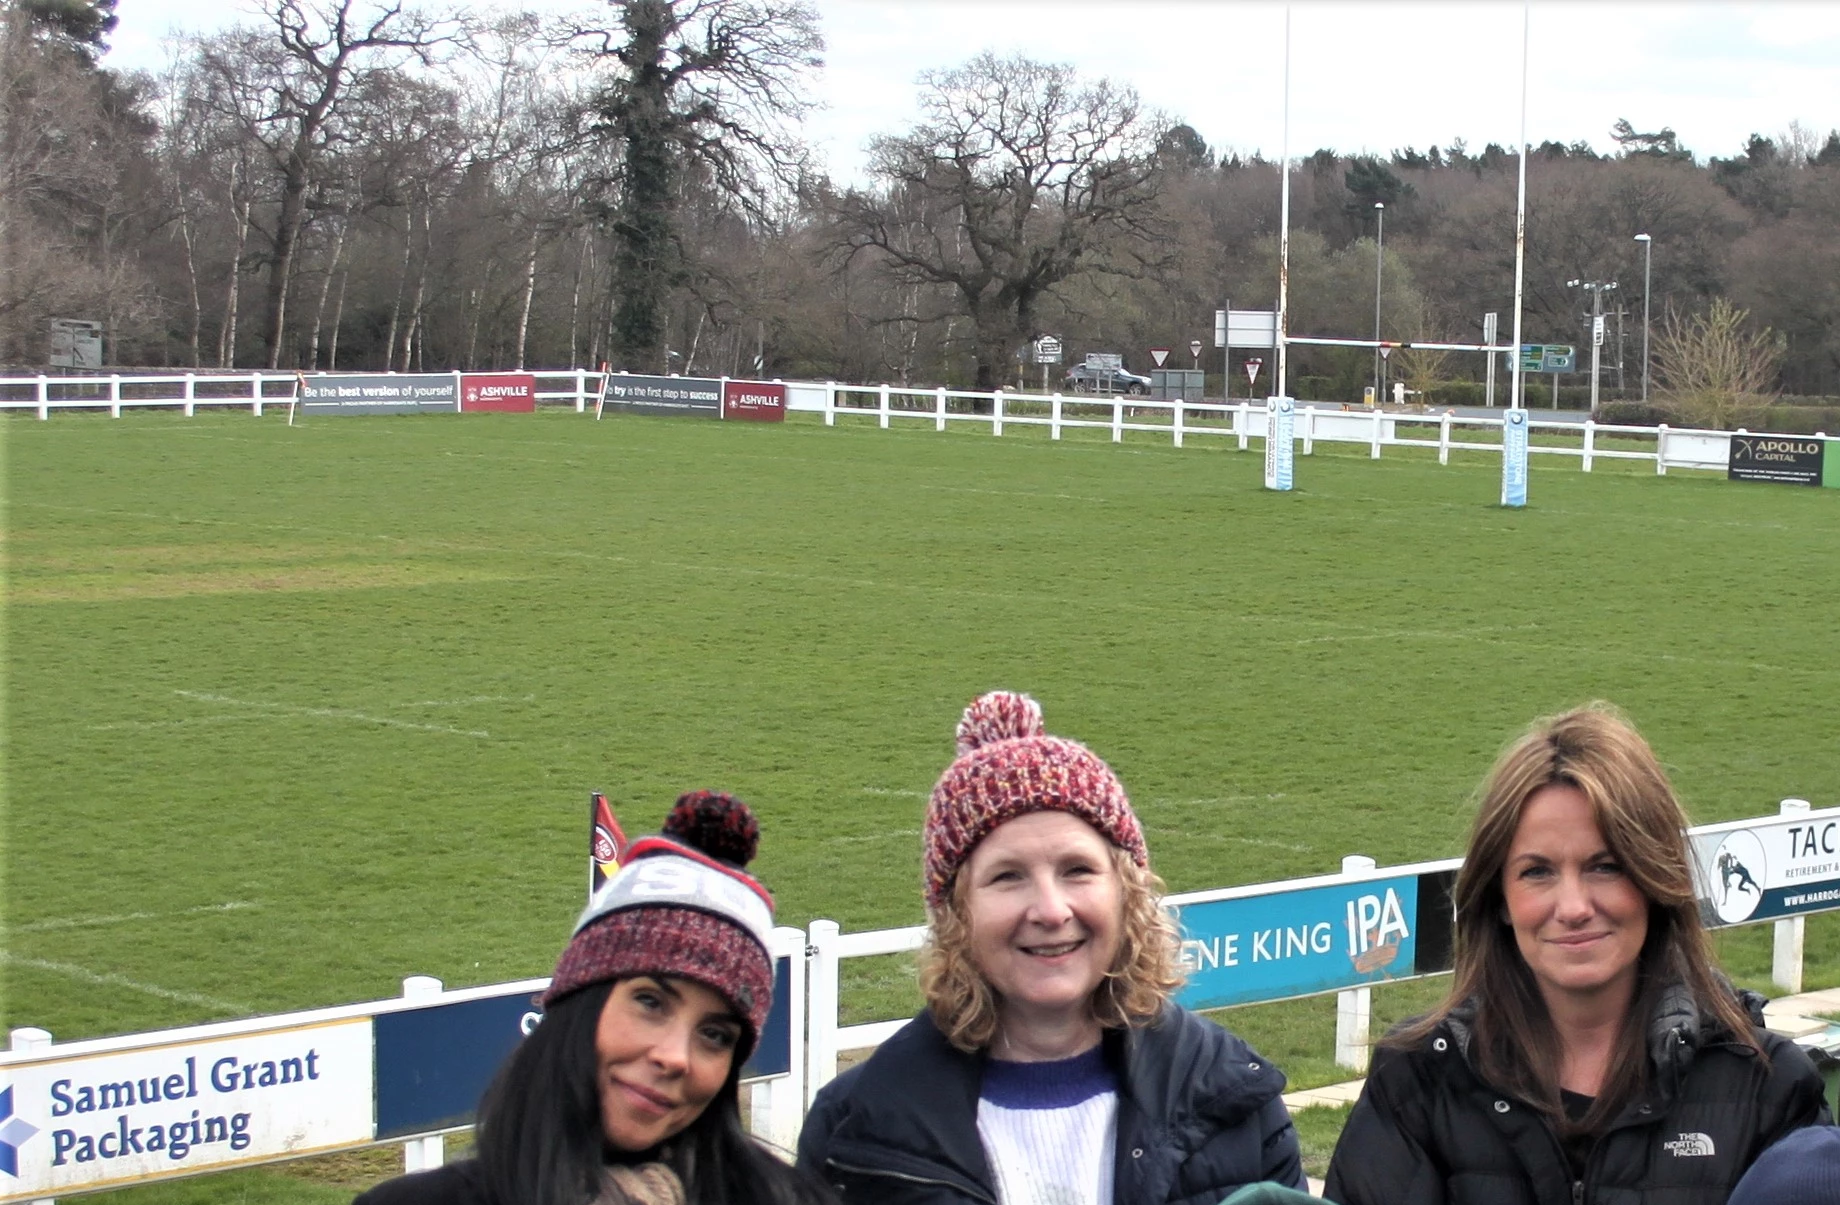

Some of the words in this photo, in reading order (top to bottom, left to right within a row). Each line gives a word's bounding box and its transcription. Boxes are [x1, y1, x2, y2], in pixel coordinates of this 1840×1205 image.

[305, 387, 317, 397] Be
[320, 387, 336, 397] the
[338, 386, 361, 396] best
[363, 386, 400, 396] version
[402, 386, 413, 396] of
[414, 386, 454, 398] yourself
[480, 386, 528, 396] ASHVILLE
[614, 386, 626, 398] try
[627, 387, 634, 396] is
[634, 387, 647, 397] the
[647, 386, 662, 398] first
[662, 388, 678, 400] step
[680, 389, 689, 399] to
[690, 391, 719, 400] success
[740, 394, 779, 406] ASHVILLE
[1756, 441, 1819, 454] APOLLO
[1755, 453, 1796, 462] CAPITAL
[1785, 863, 1832, 878] RETIREMENT
[1834, 862, 1840, 871] &
[1180, 933, 1240, 971] ENE
[1252, 922, 1332, 962] KING
[1346, 887, 1409, 957] IPA
[51, 1057, 198, 1118] Samuel
[210, 1048, 321, 1093] Grant
[52, 1109, 252, 1168] Packaging
[1664, 1141, 1697, 1150] NORTH
[1673, 1149, 1699, 1157] FACE
